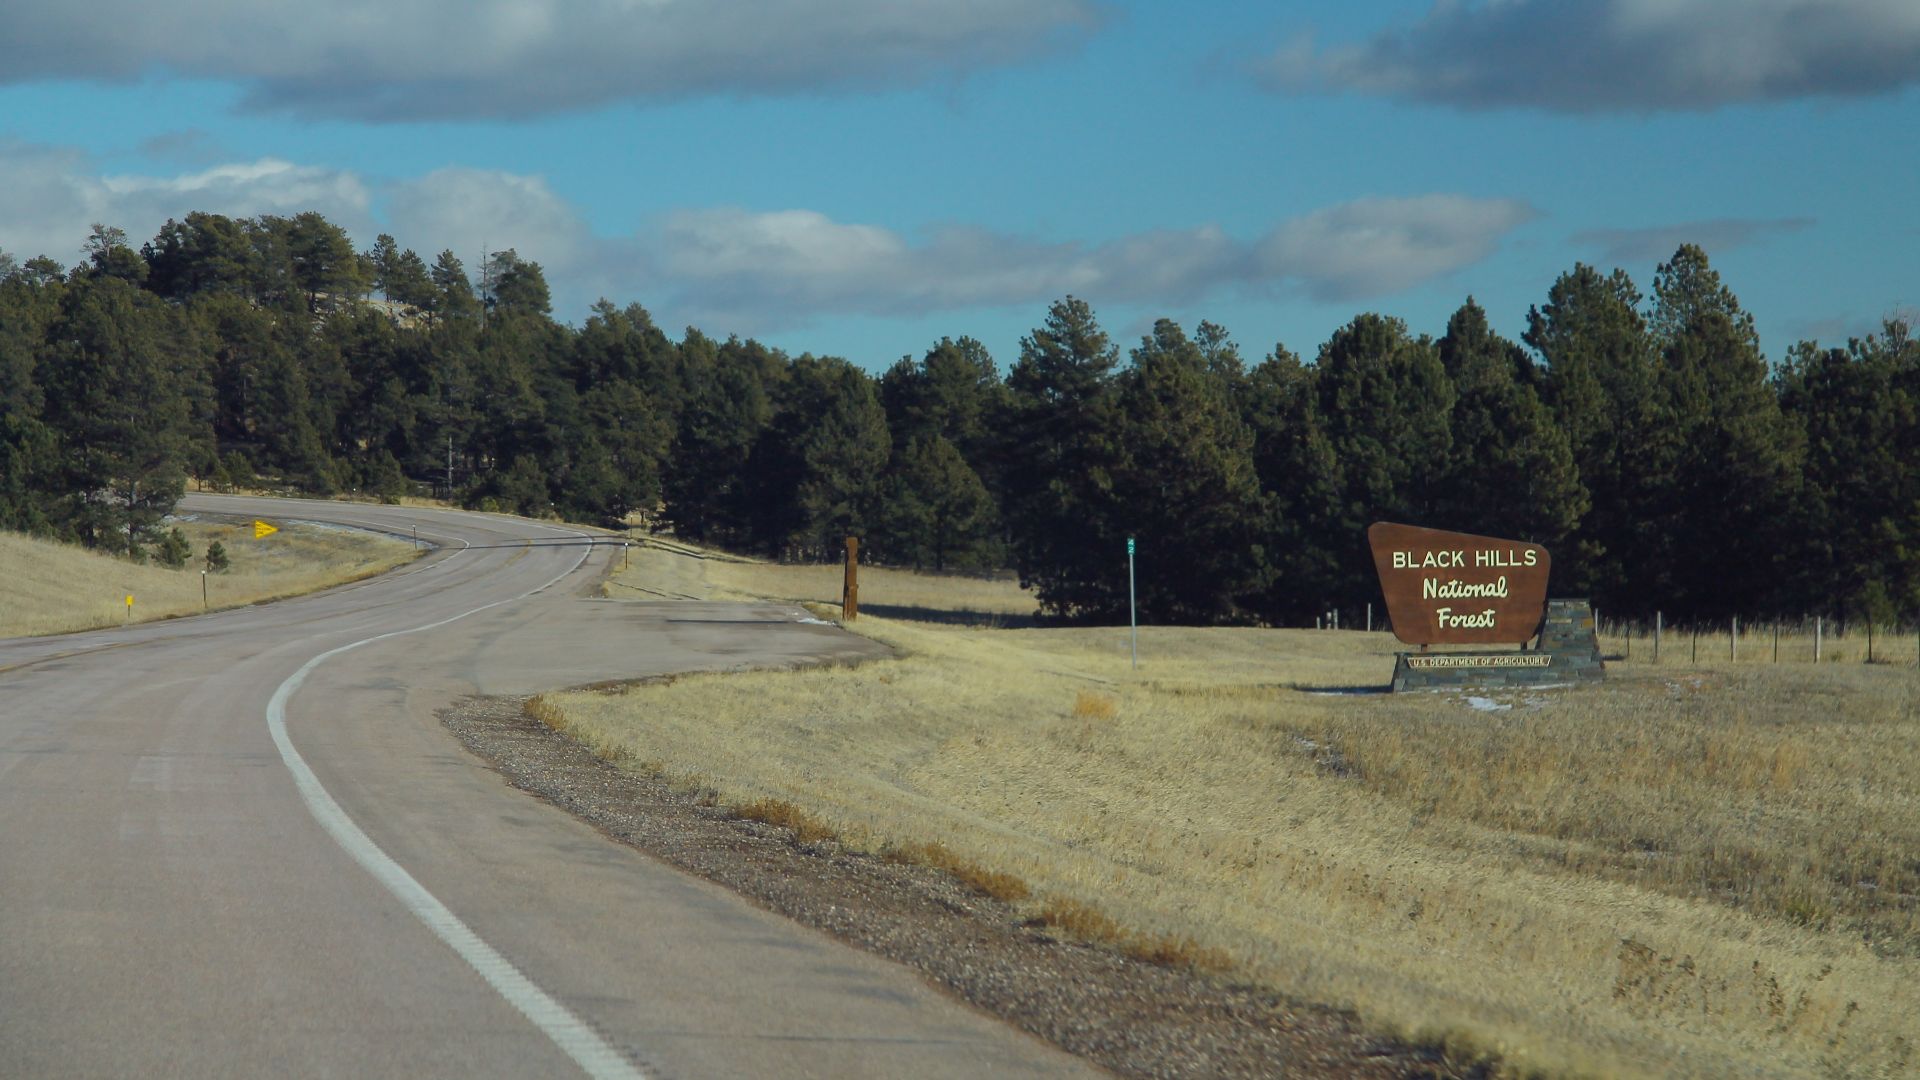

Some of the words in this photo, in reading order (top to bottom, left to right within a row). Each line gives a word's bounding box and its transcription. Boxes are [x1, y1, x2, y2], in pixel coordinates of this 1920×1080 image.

[1393, 551, 1464, 568] BLACK
[1476, 550, 1536, 567] HILLS
[1423, 576, 1507, 599] National
[1437, 608, 1495, 628] Forest
[1430, 657, 1479, 667] DEPARTMENT
[1481, 656, 1490, 666] OF
[1493, 656, 1544, 666] AGRICULTURE
